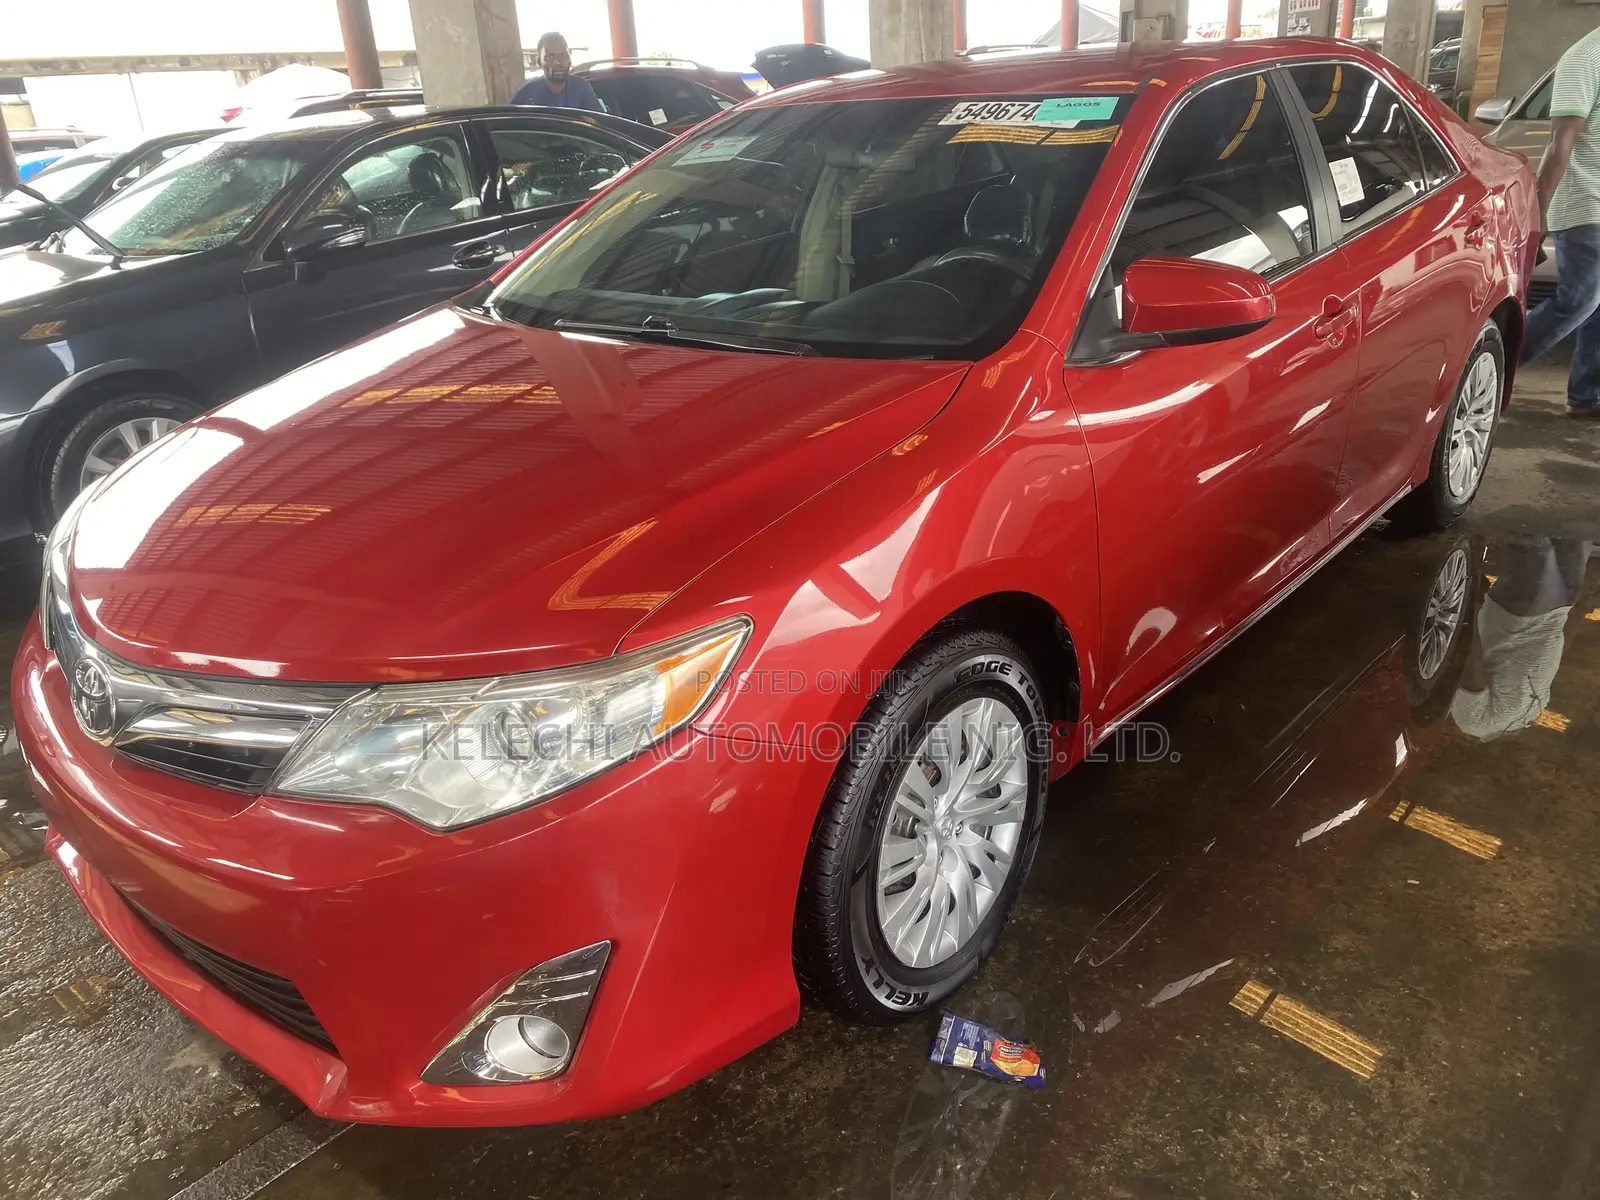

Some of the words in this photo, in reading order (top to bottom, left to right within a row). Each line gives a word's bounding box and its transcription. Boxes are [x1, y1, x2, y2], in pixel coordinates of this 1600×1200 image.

[956, 102, 1041, 121] 549674
[953, 660, 1012, 684] EDGE
[860, 955, 930, 1007] KELLY
